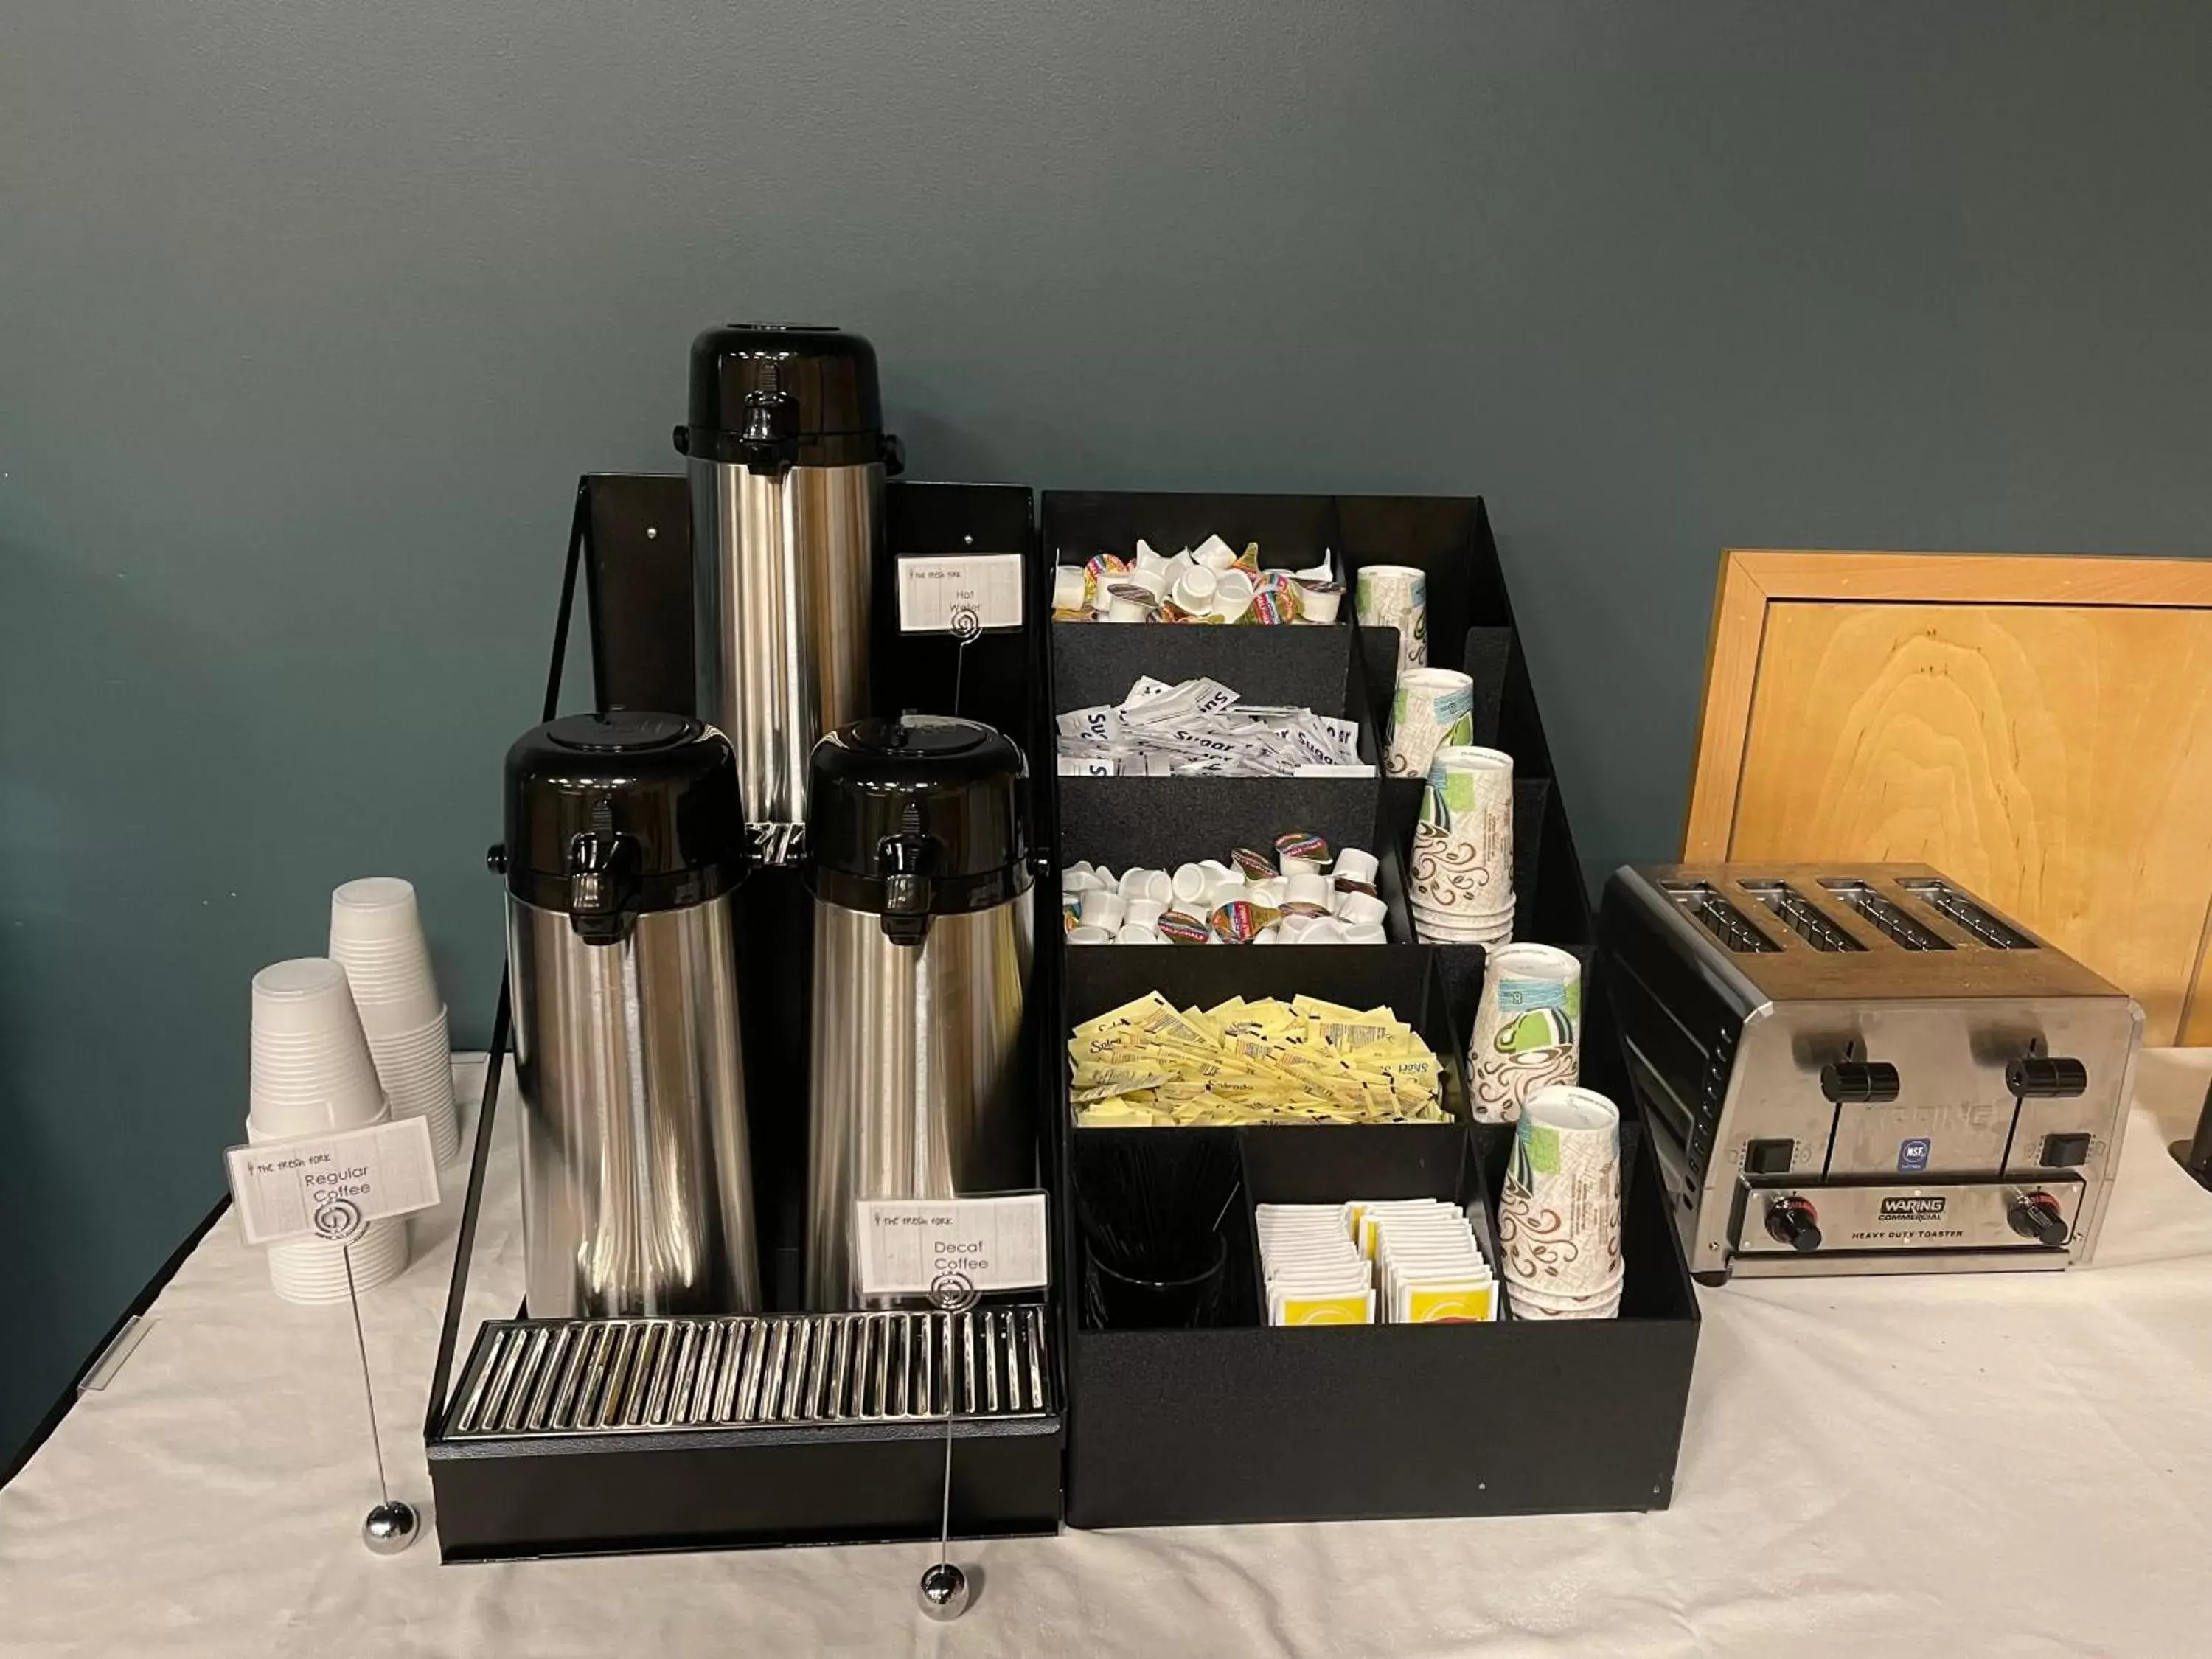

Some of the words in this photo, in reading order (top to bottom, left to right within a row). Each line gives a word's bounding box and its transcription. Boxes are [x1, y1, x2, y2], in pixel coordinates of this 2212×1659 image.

[956, 590, 975, 599] Hot
[305, 1166, 369, 1186] Regular
[313, 1183, 371, 1203] Coffee
[1885, 1199, 1944, 1214] WARING
[1878, 1214, 1942, 1222] COMMERCIAL
[1851, 1231, 1886, 1239] HEAVY
[1888, 1231, 1915, 1239] DUTY
[1917, 1230, 1964, 1239] TOASTER
[933, 1240, 984, 1253] Decaf
[934, 1257, 990, 1270] Coffee
